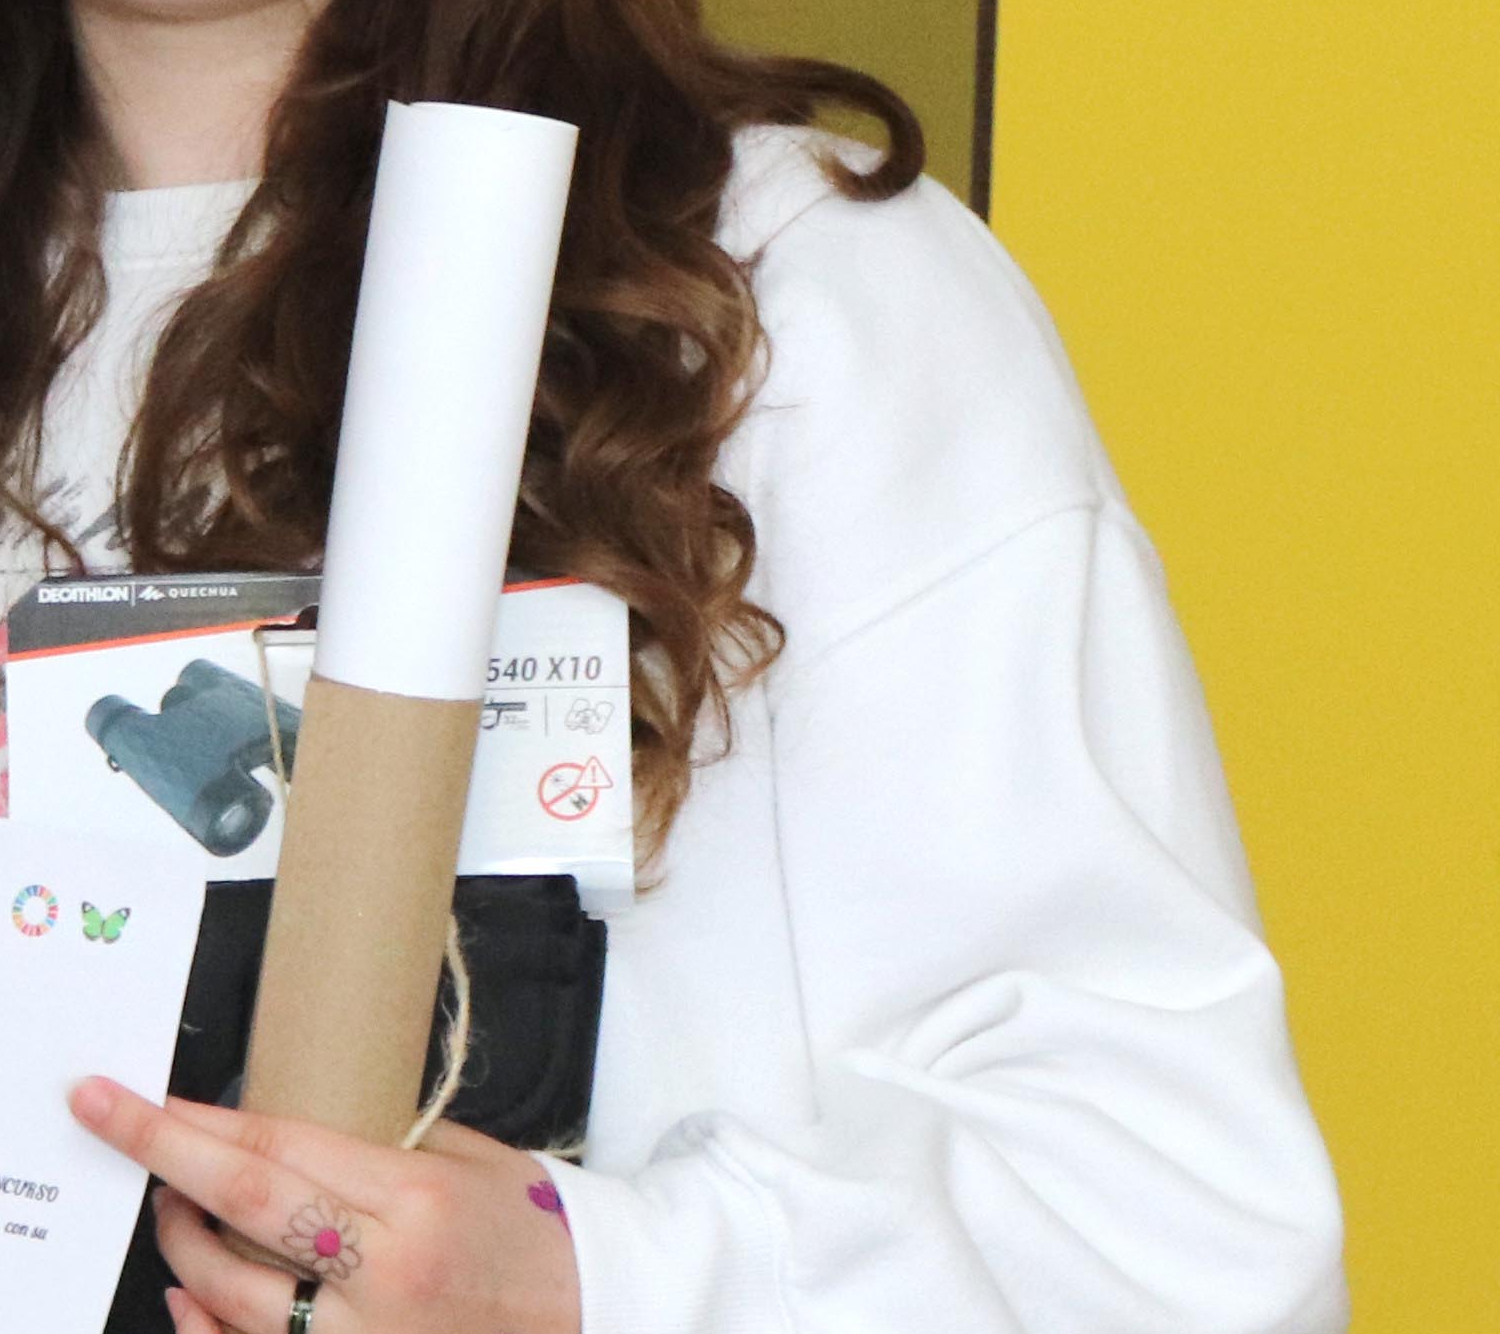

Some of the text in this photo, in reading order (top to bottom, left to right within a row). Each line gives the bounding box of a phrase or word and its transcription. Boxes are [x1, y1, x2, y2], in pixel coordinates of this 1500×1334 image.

[37, 585, 239, 604] DECATHLON QUECHUA
[486, 655, 603, 683] 540 X10
[4, 1219, 28, 1238] con
[30, 1225, 49, 1242] su
